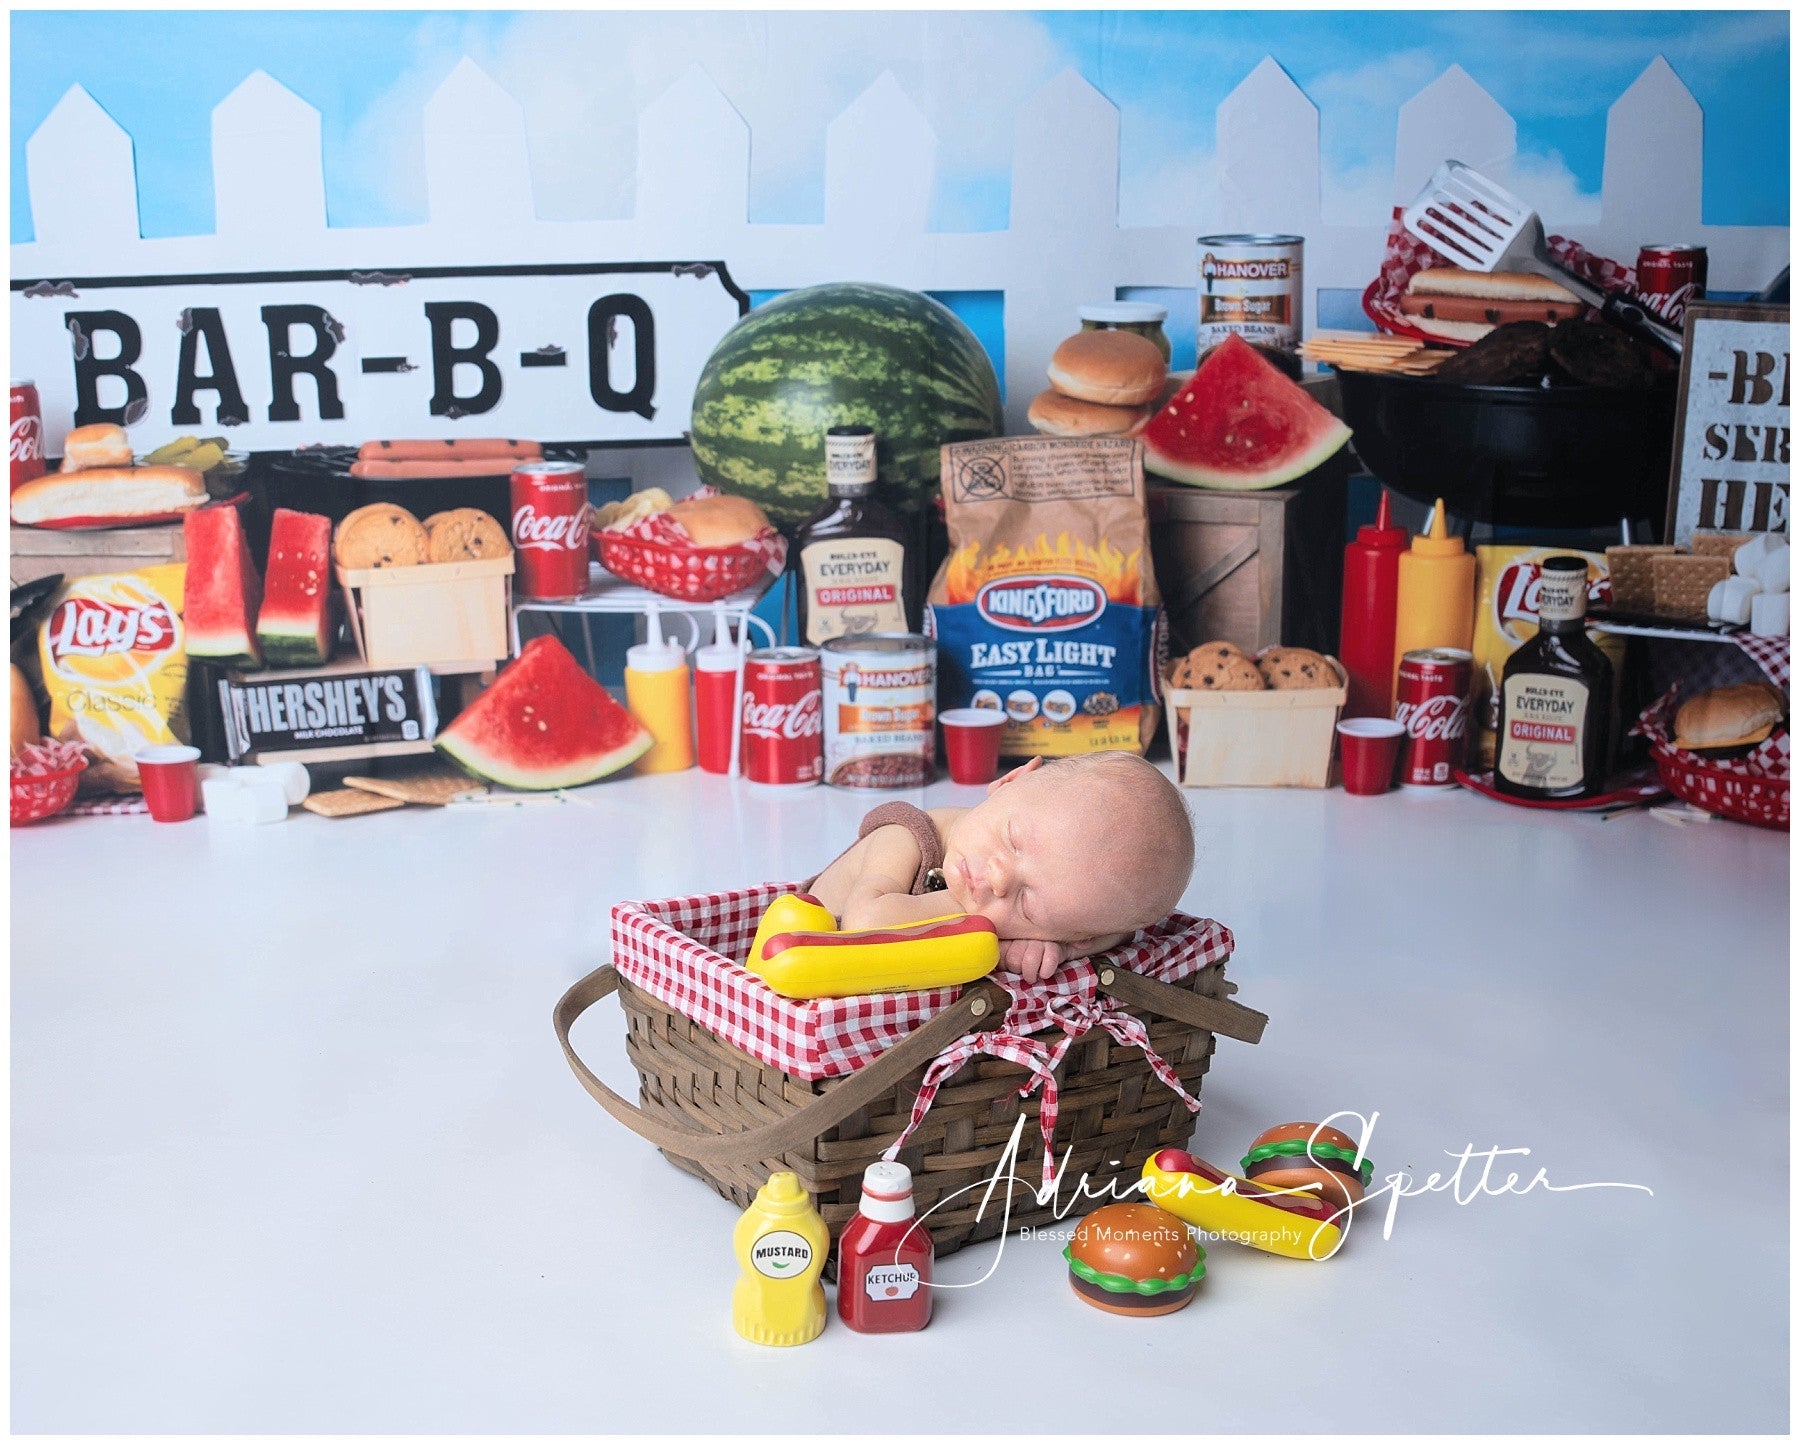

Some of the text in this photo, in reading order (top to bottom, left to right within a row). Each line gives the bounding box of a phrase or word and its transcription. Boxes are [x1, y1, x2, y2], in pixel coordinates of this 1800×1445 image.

[1217, 262, 1287, 278] HANOVER
[1215, 298, 1271, 315] Brown Sugar
[65, 293, 656, 427] BAR-B-Q
[820, 561, 889, 577] EVERYDAY
[820, 588, 892, 603] ORIGINAL
[989, 583, 1096, 623] KINGSFORD
[970, 638, 1117, 669] EASY LIGHT
[1024, 665, 1055, 677] BAG
[67, 690, 157, 713] Classic
[246, 675, 407, 733] HERSHEY'S
[1516, 696, 1575, 714] EVERYDAY
[316, 725, 364, 739] CHOCOLATE
[1513, 722, 1571, 741] ORIGINAL
[756, 1246, 808, 1259] MUSTARD
[867, 1272, 916, 1285] KETCHUP
